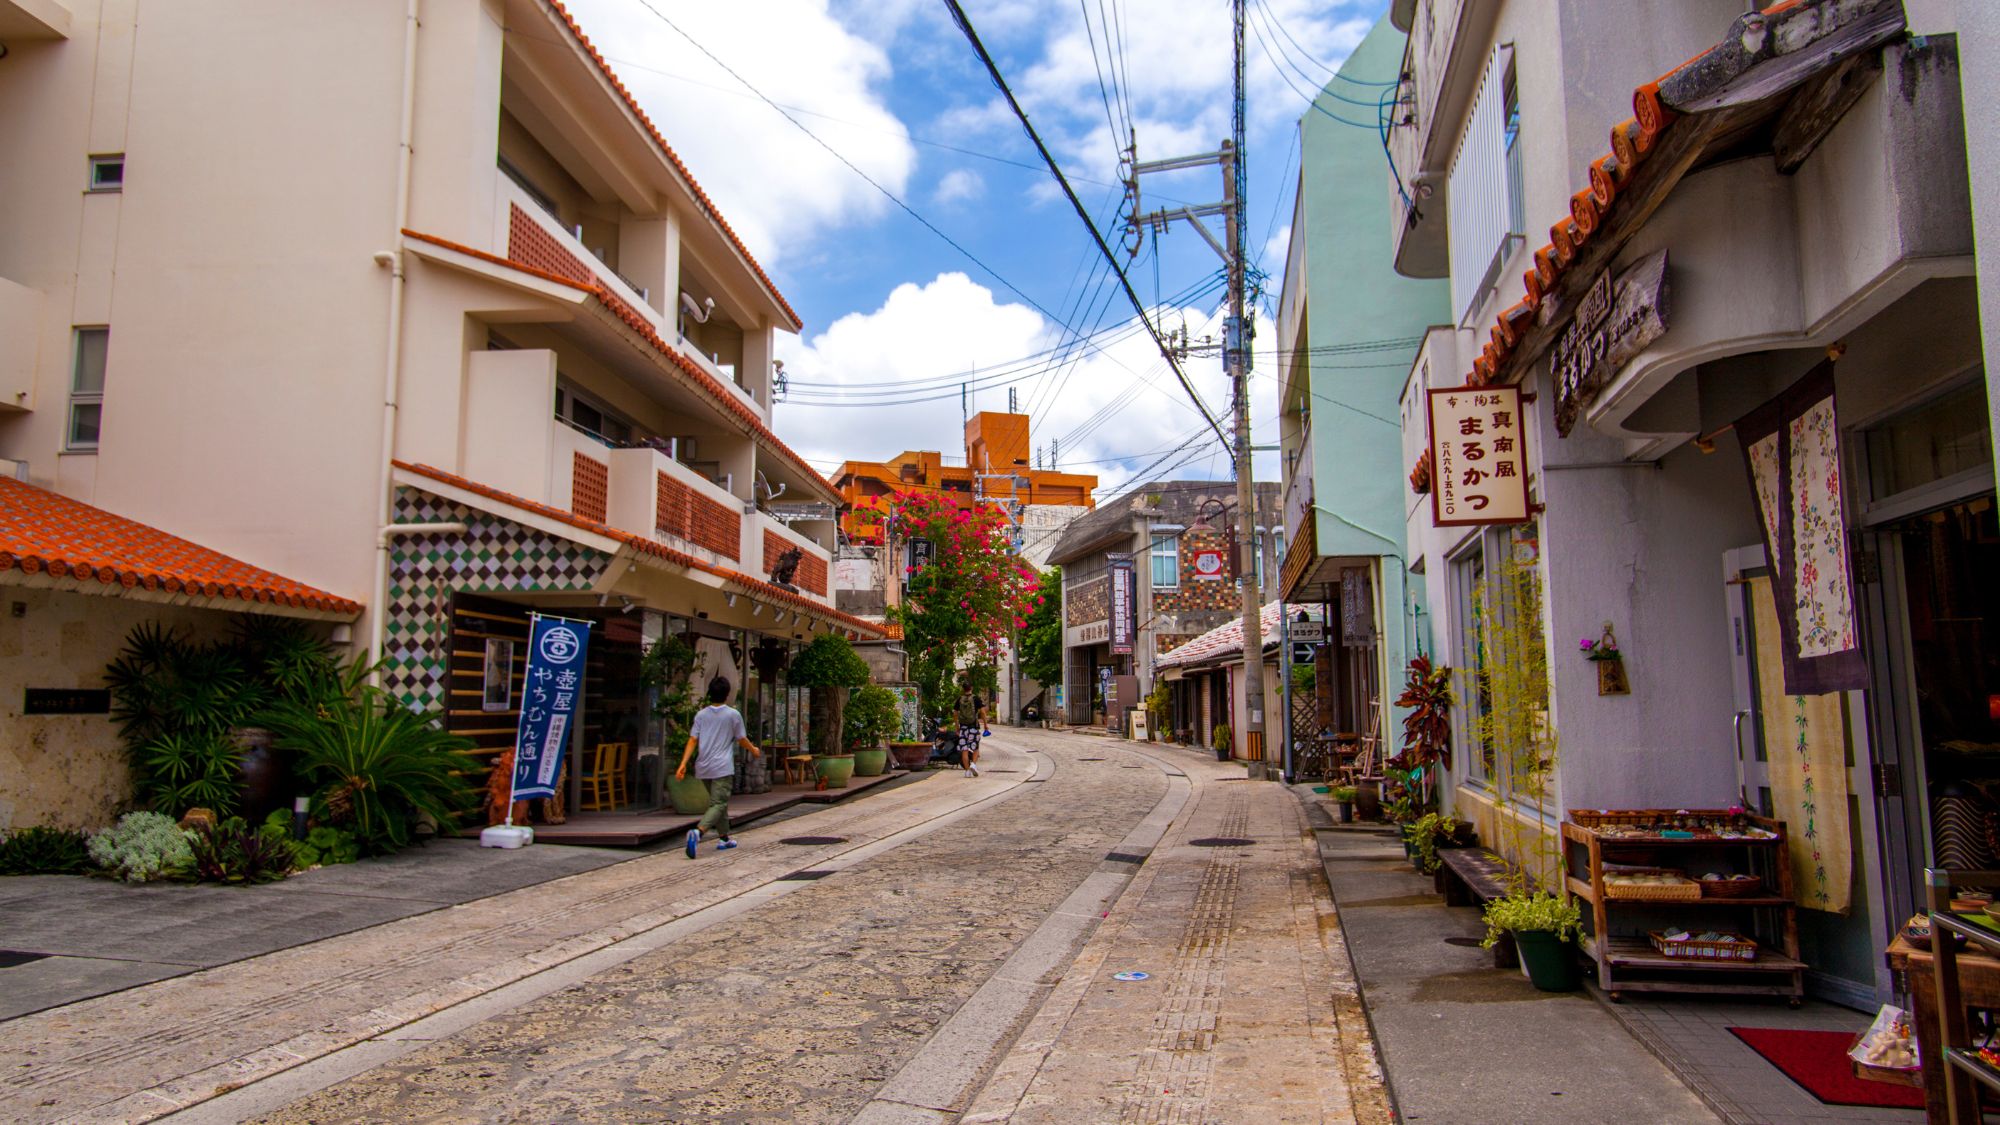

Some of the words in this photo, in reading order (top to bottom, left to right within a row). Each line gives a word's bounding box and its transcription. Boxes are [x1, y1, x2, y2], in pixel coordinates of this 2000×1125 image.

[1458, 416, 1490, 511] まるかつ
[1491, 411, 1517, 478] 真南風
[517, 667, 553, 782] やちむん通り
[552, 668, 578, 711] 壺屋
